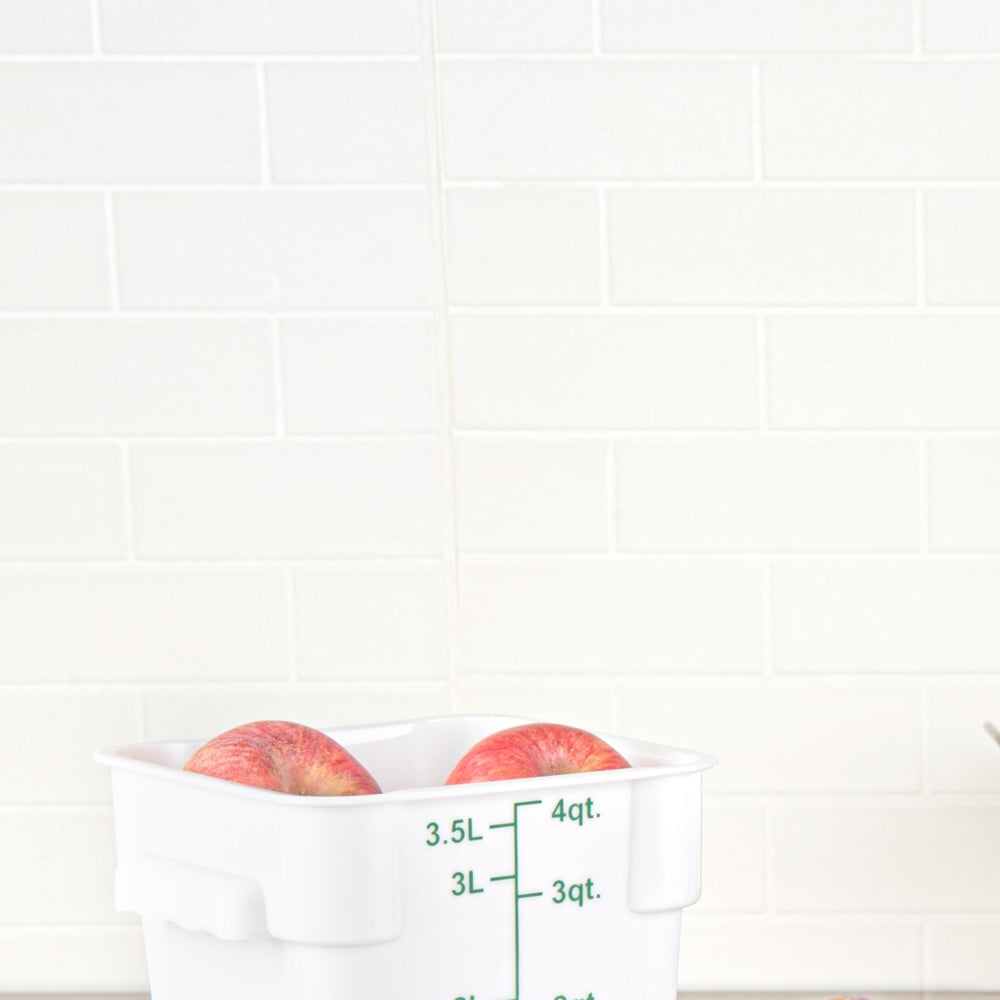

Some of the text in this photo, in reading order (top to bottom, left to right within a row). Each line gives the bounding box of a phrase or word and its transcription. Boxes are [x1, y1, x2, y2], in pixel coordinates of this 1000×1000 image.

[550, 797, 601, 827] 4qt.
[425, 818, 484, 847] 3.5L
[451, 870, 485, 897] 3L
[551, 877, 601, 907] 3qt.
